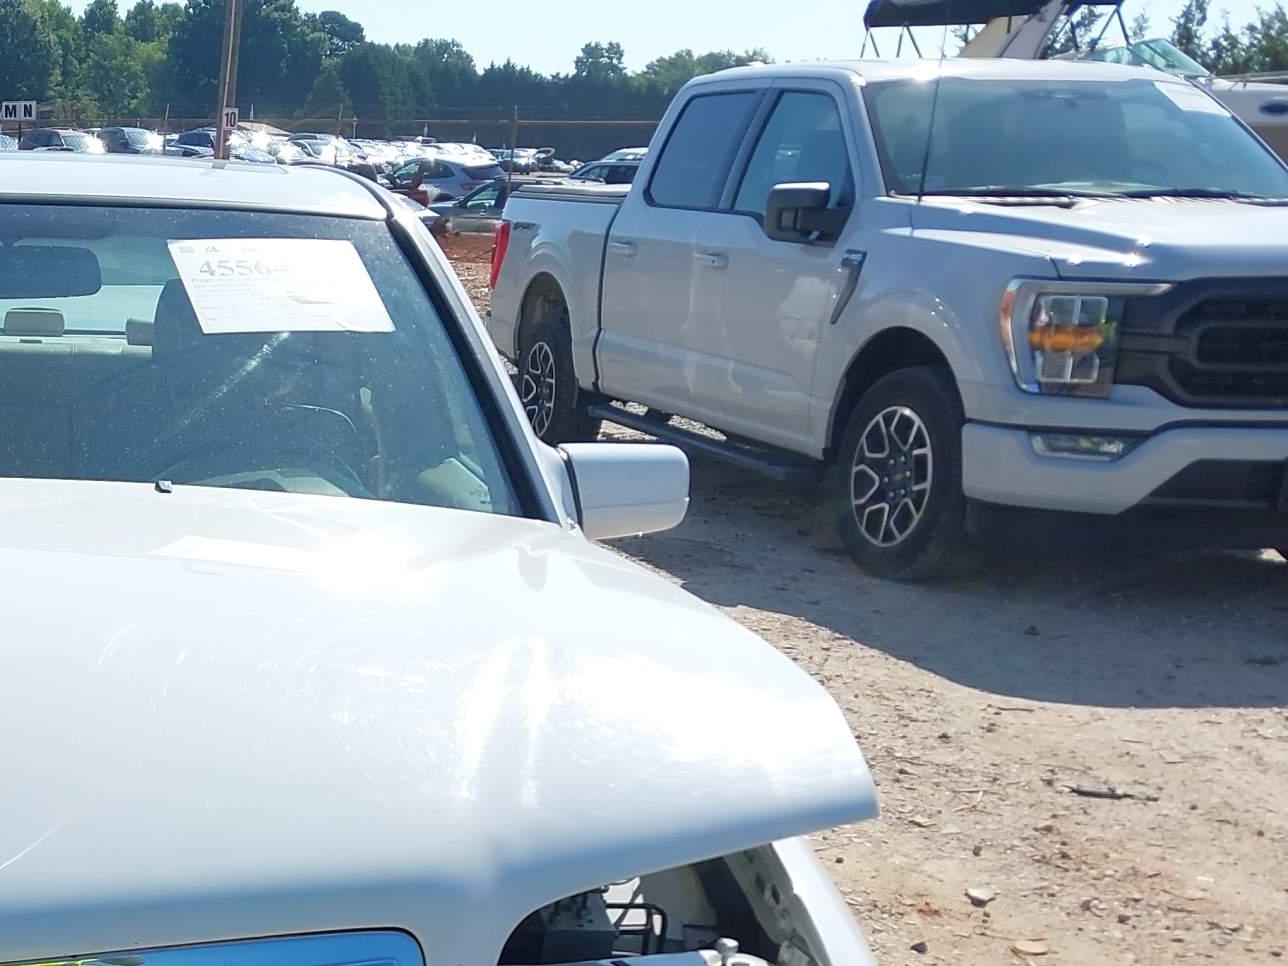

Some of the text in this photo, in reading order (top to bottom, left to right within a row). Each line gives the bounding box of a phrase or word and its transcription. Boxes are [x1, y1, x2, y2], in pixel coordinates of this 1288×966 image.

[4, 103, 33, 118] M N
[224, 111, 237, 127] 10
